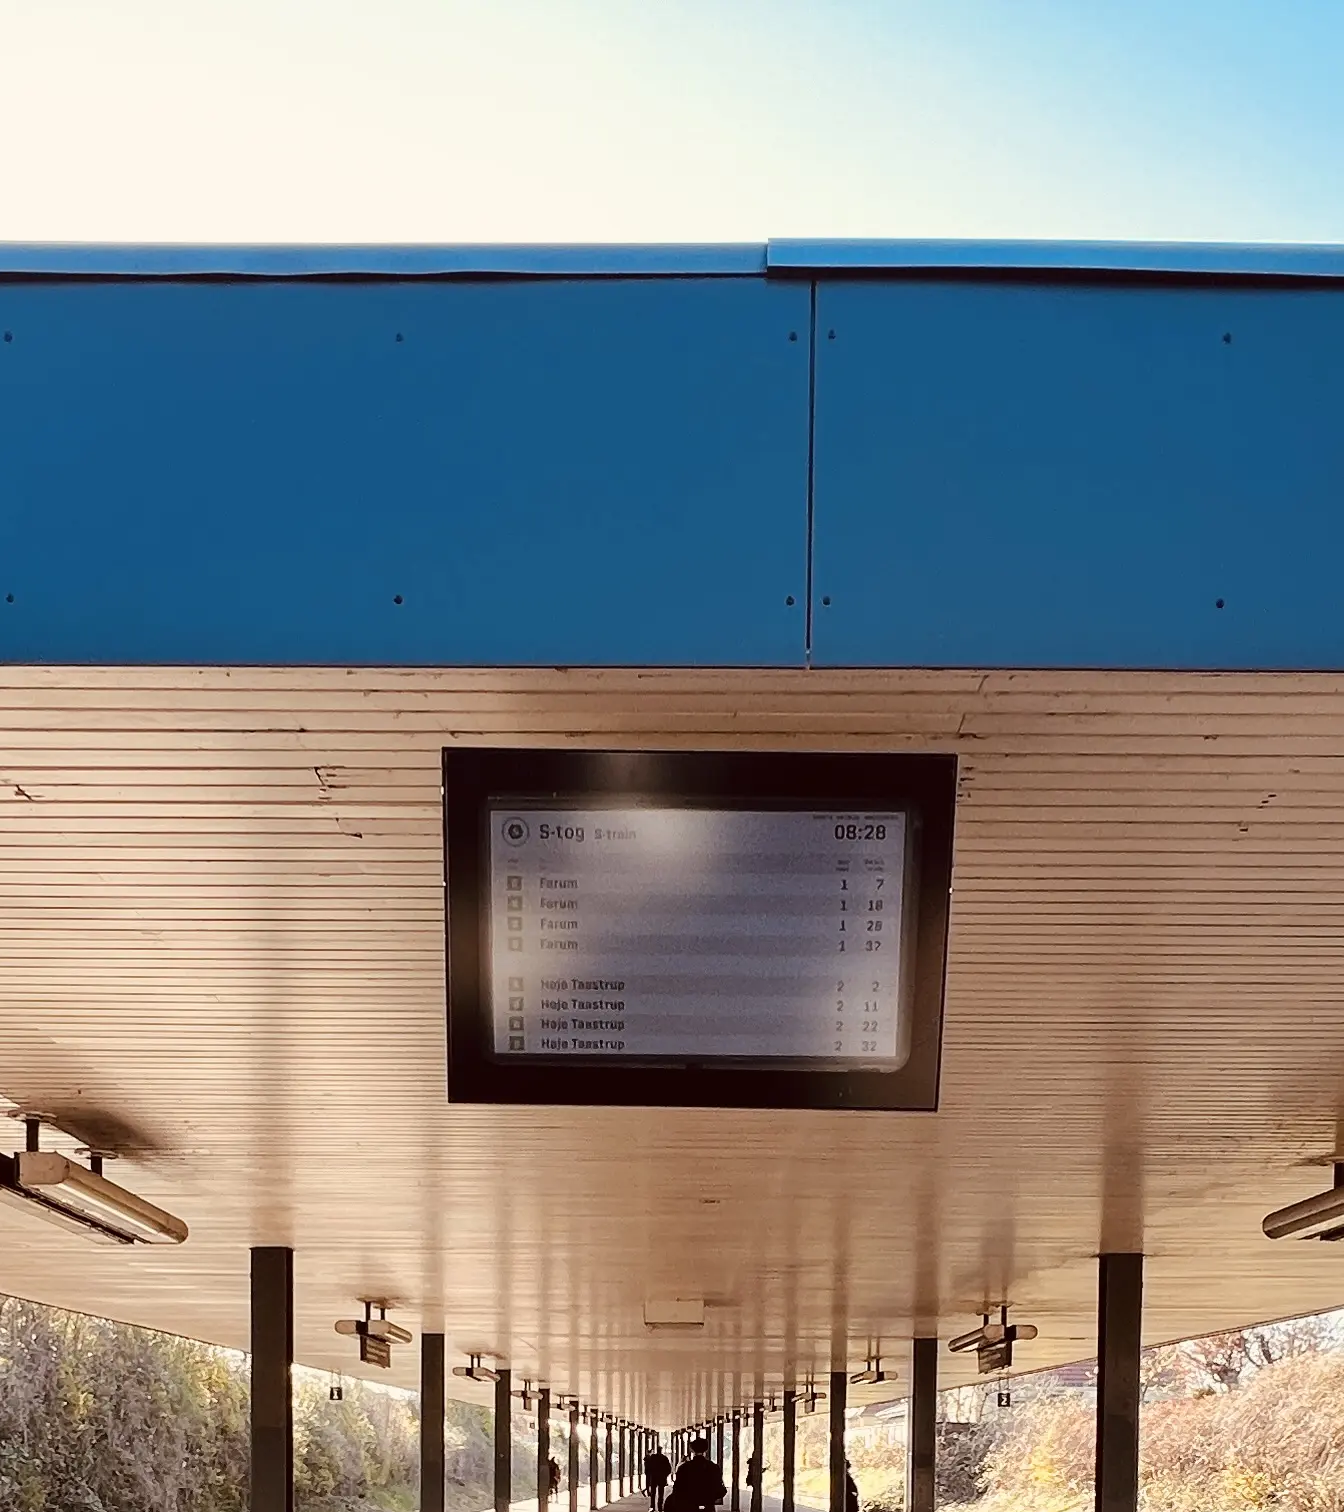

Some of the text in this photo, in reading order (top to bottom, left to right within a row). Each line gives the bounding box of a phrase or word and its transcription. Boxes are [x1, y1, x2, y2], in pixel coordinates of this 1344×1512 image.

[539, 824, 585, 842] S-tog
[834, 824, 886, 840] 08:28
[841, 879, 848, 890] 1
[876, 879, 884, 890] 7
[840, 900, 847, 911] 1
[839, 920, 846, 931] 1
[838, 940, 846, 952] 1
[837, 981, 844, 992] 2
[837, 1001, 844, 1012] 2
[836, 1021, 843, 1032] 2
[835, 1041, 842, 1052] 2
